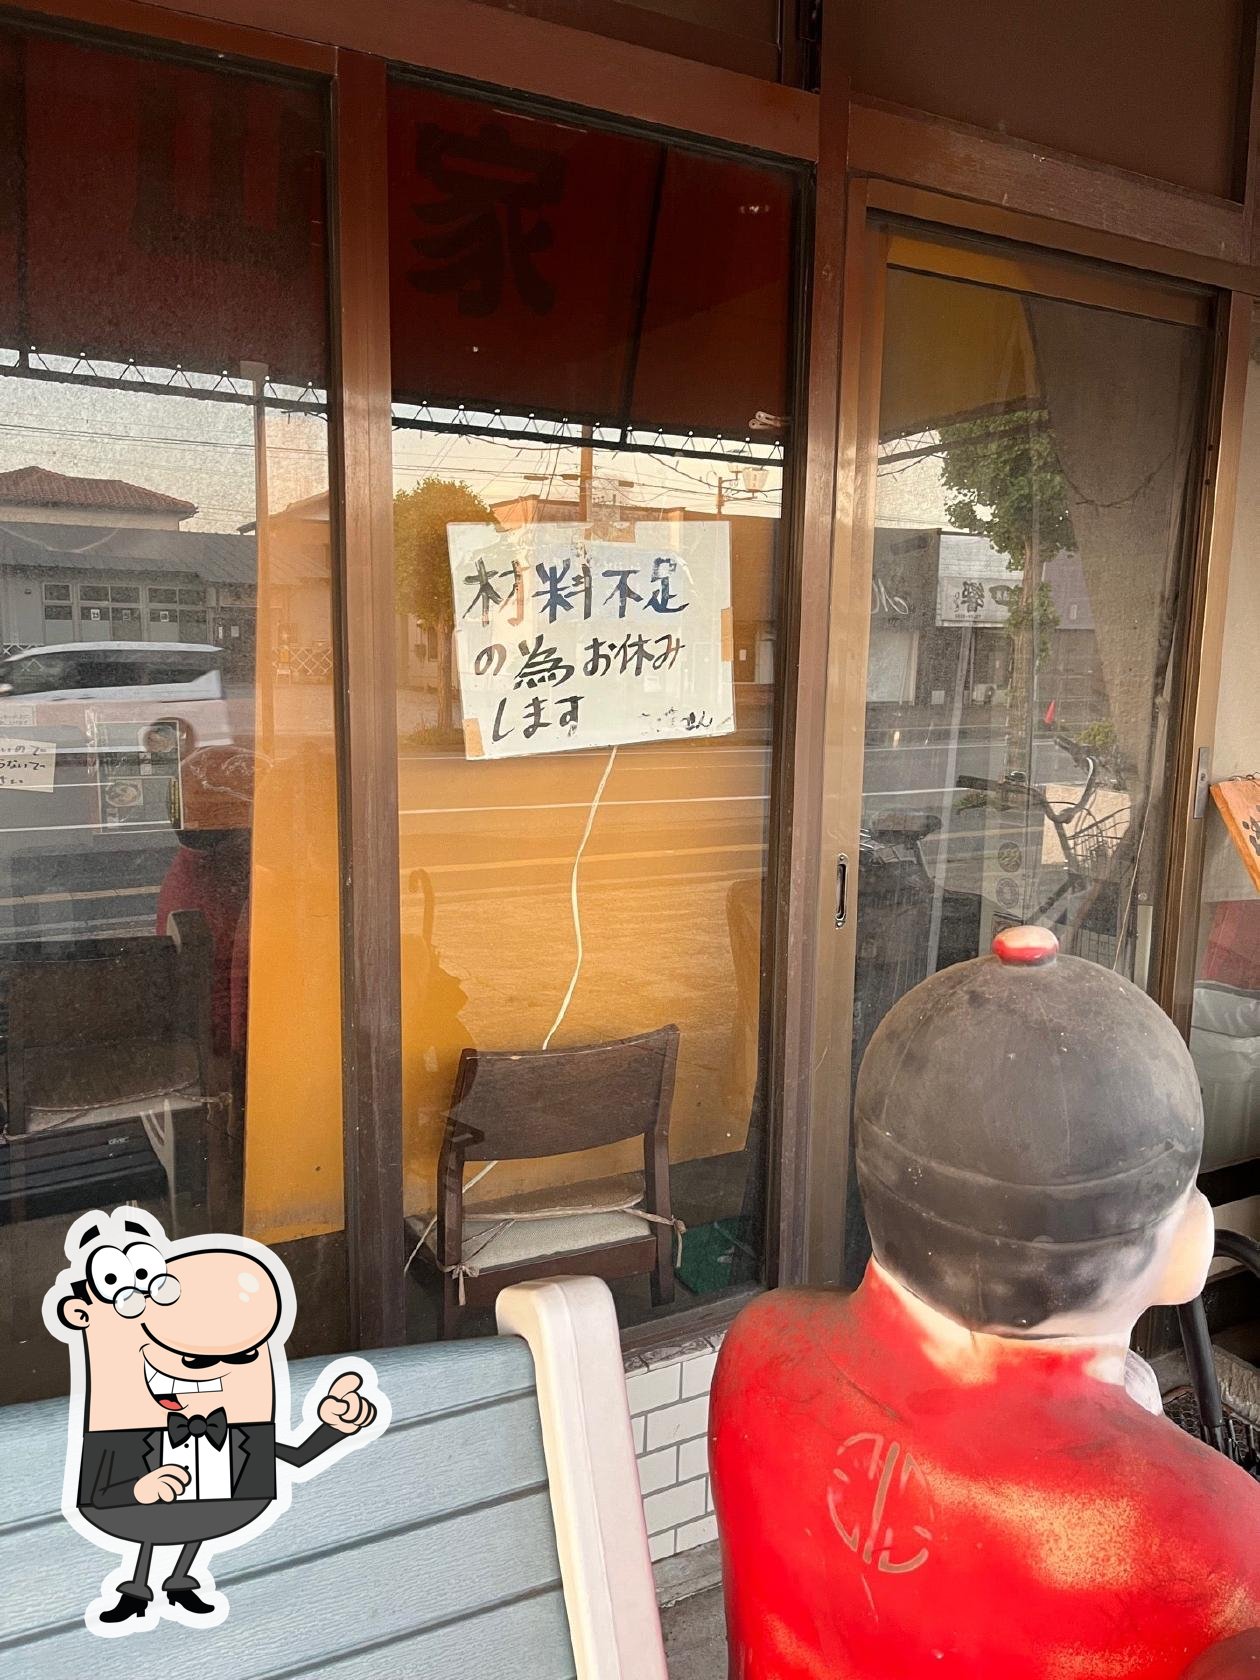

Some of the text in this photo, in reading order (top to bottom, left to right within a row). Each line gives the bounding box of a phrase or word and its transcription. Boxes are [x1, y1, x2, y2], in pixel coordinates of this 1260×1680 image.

[407, 123, 565, 316] 家
[462, 556, 690, 627] 材料不足
[474, 633, 686, 690] の為お休み
[492, 694, 585, 743] します
